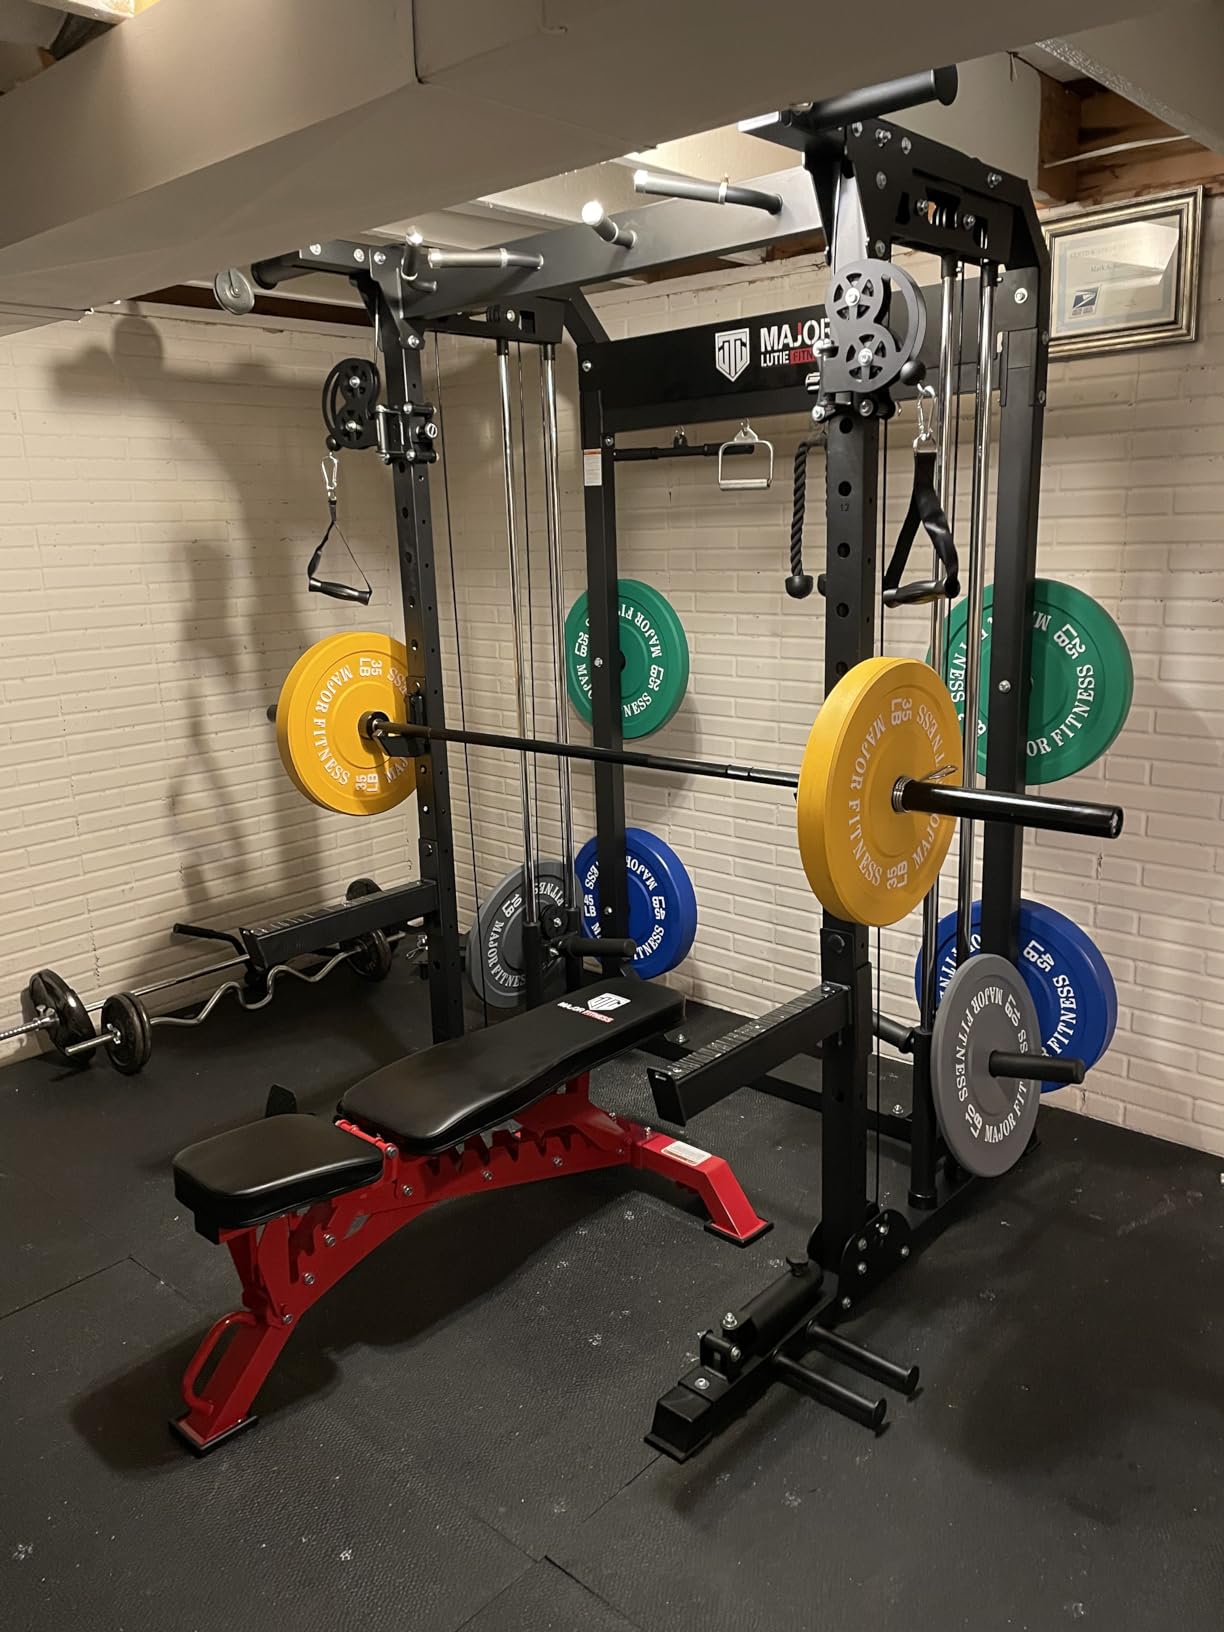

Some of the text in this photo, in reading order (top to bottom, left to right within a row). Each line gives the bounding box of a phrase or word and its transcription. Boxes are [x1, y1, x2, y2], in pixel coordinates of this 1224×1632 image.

[761, 351, 789, 367] LUTIE
[578, 632, 589, 646] 25
[635, 612, 662, 658] MAJOR
[1054, 624, 1078, 646] LB
[575, 642, 587, 657] LB
[1066, 638, 1086, 659] 25
[359, 657, 372, 677] LB
[371, 658, 383, 676] 35
[650, 664, 664, 680] LB
[949, 651, 966, 703] NESS
[648, 677, 661, 691] 25
[623, 692, 652, 717] NESS
[891, 698, 902, 726] LB
[902, 698, 912, 721] 35
[1051, 664, 1095, 747] FITNESS
[313, 664, 353, 785] MAJOR FITNESS
[355, 775, 367, 791] 35
[366, 773, 379, 792] LB
[849, 714, 886, 886] MAJOR FITNESS
[912, 813, 940, 870] MAJO
[887, 868, 898, 889] 35
[897, 860, 908, 888] LB
[502, 900, 515, 918] LB
[511, 893, 523, 907] 10
[584, 894, 594, 906] 45
[652, 896, 665, 908] LB
[584, 905, 597, 917] LB
[654, 908, 666, 920] 45
[487, 920, 504, 968] MAJOR
[1023, 939, 1045, 962] LB
[1037, 953, 1054, 972] 45
[1004, 993, 1017, 1019] LB
[1047, 974, 1077, 1054] FITNESS
[1012, 1007, 1021, 1027] 10
[955, 986, 1003, 1102] MAJOR FITNESS
[965, 1104, 976, 1124] 10
[970, 1112, 983, 1138] LB
[984, 1112, 1016, 1143] MAJOR
